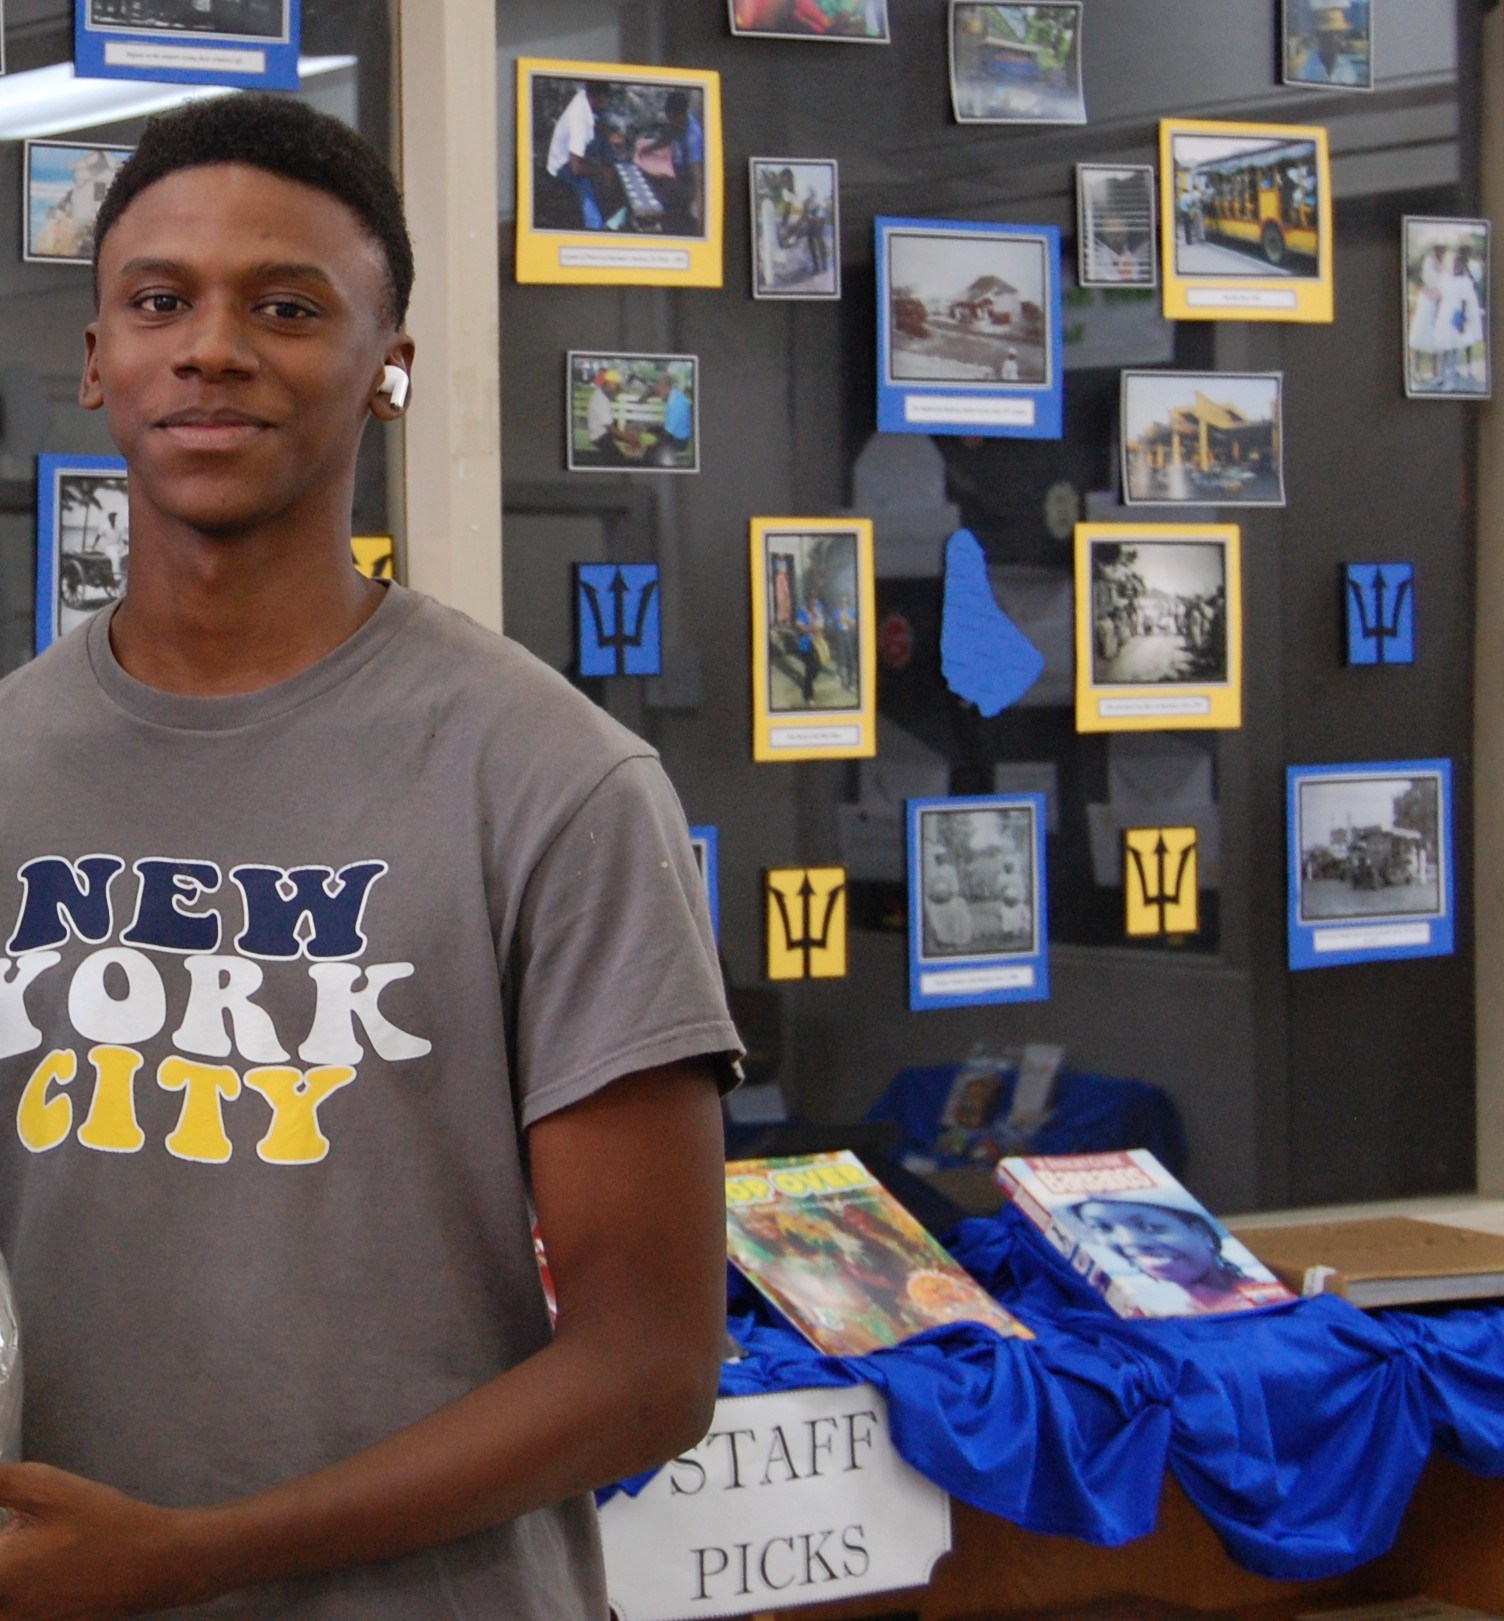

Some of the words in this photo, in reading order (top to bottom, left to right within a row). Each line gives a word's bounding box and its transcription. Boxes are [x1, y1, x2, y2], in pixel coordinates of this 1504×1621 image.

[6, 853, 389, 962] NEW
[16, 1044, 357, 1165] CITY
[725, 1176, 772, 1203] OP
[772, 1162, 874, 1196] OVER
[670, 1410, 878, 1496] STAFF
[690, 1525, 870, 1601] PICKS
